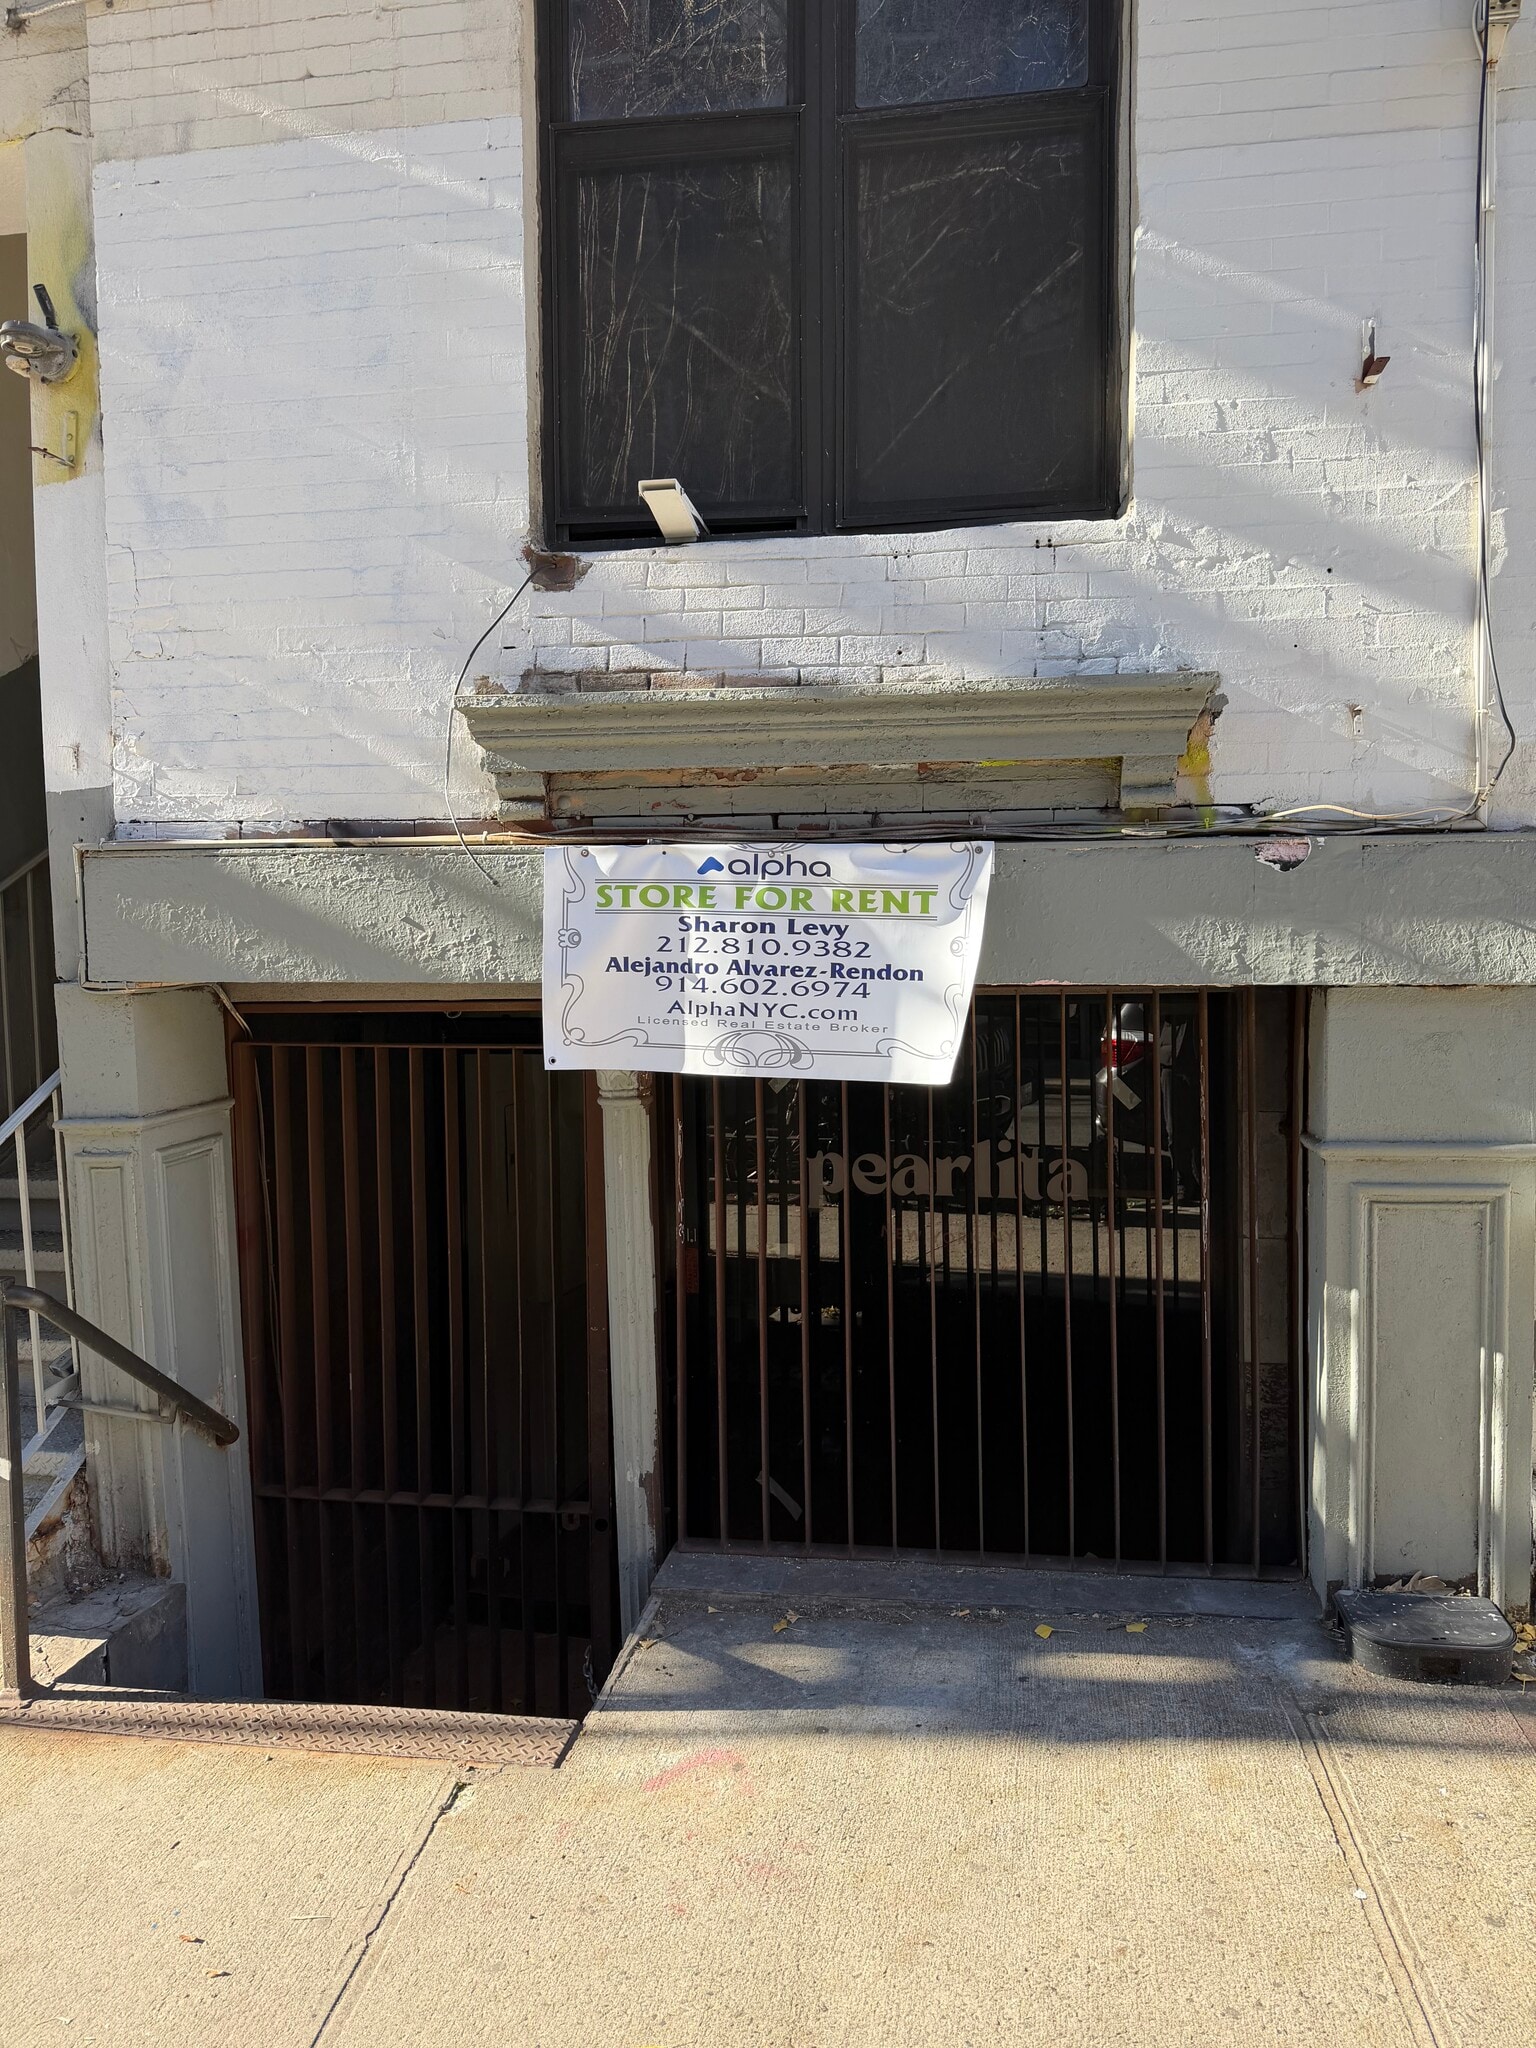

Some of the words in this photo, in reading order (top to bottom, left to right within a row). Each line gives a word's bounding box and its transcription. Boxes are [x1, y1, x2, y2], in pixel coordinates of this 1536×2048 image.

[727, 853, 832, 880] alpha
[596, 884, 717, 909] STORE
[735, 886, 816, 912] FOR
[831, 888, 939, 915] RENT
[678, 915, 776, 935] Sharon
[787, 918, 850, 941] Levy
[656, 935, 872, 959] 212.810.9382
[605, 956, 719, 978] Alejandro
[725, 958, 924, 982] Alvarez-Rendon
[655, 975, 871, 999] 914.602.6974
[667, 1000, 858, 1021] AlphaNYC.com
[637, 1015, 709, 1028] Licensed
[717, 1019, 756, 1030] Real
[764, 1020, 821, 1032] Estate
[829, 1023, 889, 1034] Broker
[805, 1138, 1090, 1210] pearlita
